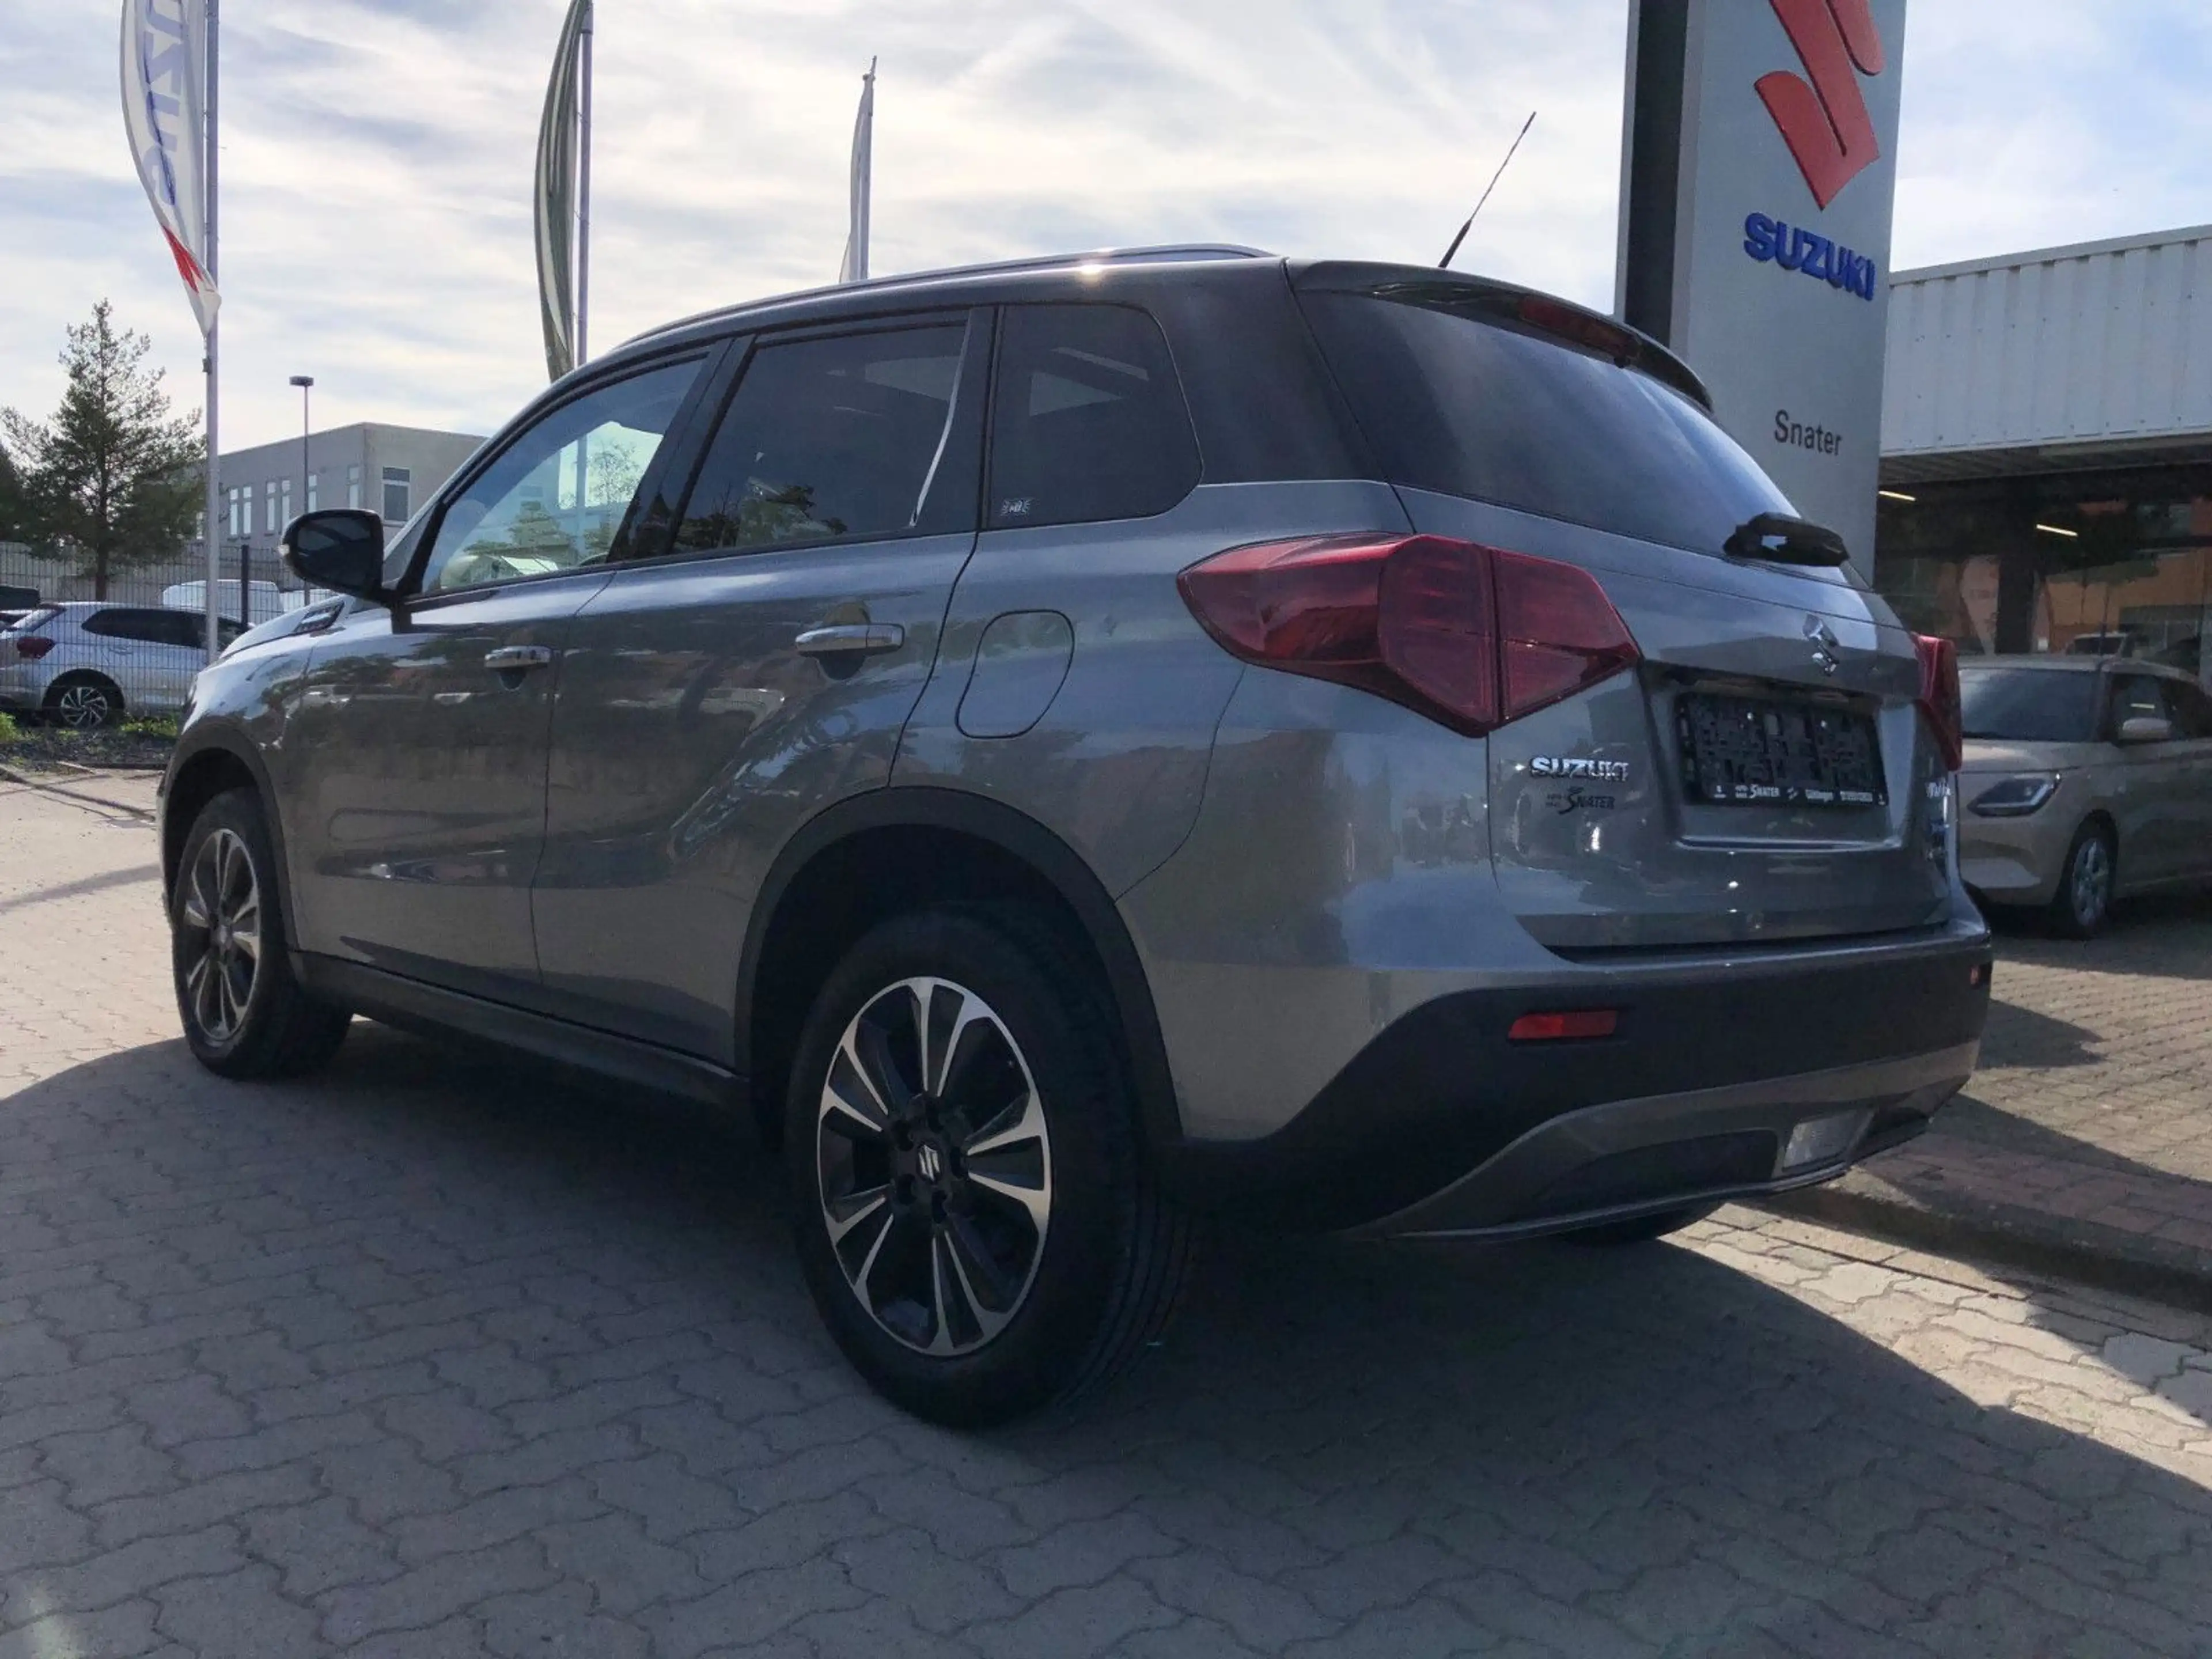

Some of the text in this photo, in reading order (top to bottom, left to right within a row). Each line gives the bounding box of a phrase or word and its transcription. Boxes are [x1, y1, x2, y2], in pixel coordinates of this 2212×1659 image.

[1744, 212, 1875, 301] SUZUKI
[1775, 409, 1842, 456] Snater
[1531, 756, 1629, 782] SUZUKI
